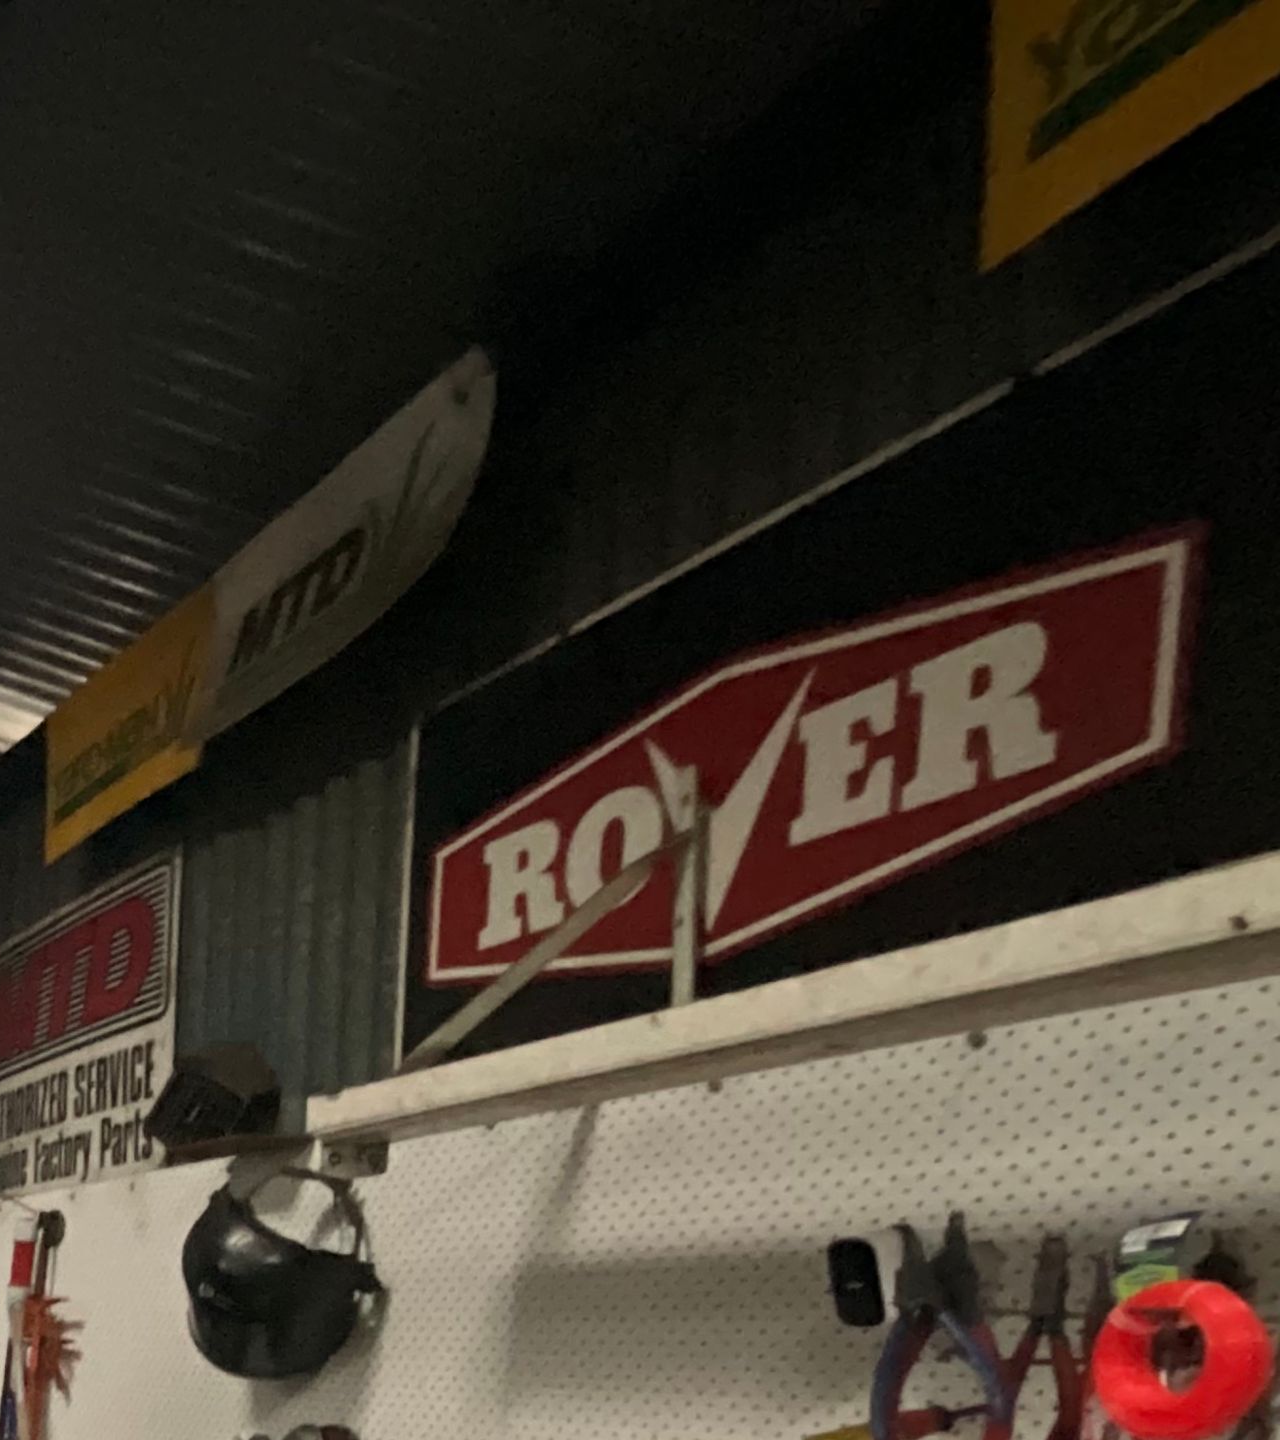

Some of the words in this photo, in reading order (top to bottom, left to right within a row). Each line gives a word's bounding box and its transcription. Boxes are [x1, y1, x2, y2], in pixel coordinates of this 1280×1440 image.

[476, 621, 1059, 951] ROVER
[73, 1040, 155, 1118] SERVICE
[34, 1129, 92, 1183] Factory
